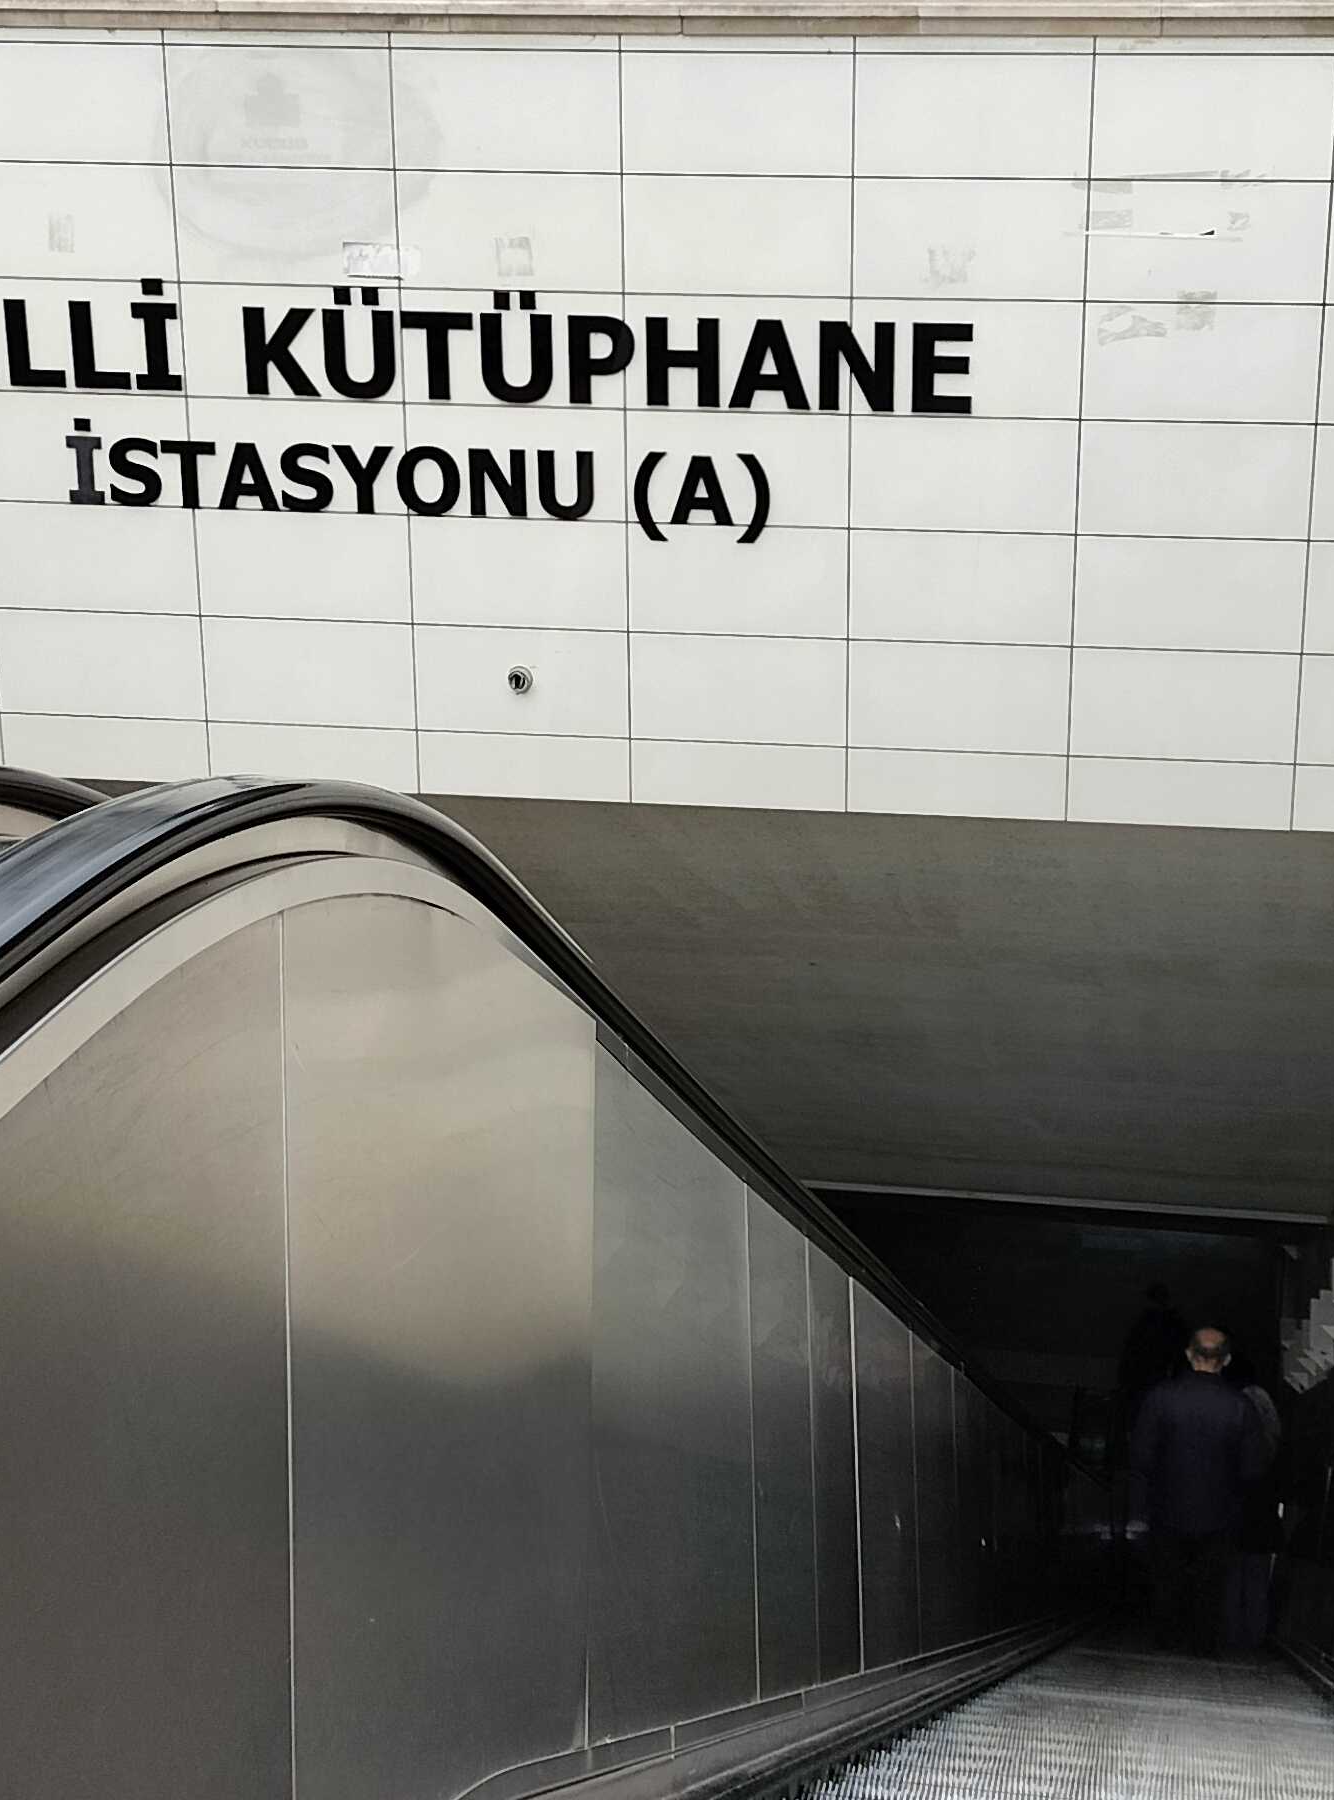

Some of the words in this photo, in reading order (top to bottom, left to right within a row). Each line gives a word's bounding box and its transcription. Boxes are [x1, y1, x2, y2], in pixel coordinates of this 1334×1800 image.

[243, 286, 973, 414] KÜTÜPHANE
[65, 418, 594, 521] İSTASYONU
[634, 452, 770, 543] (A)
